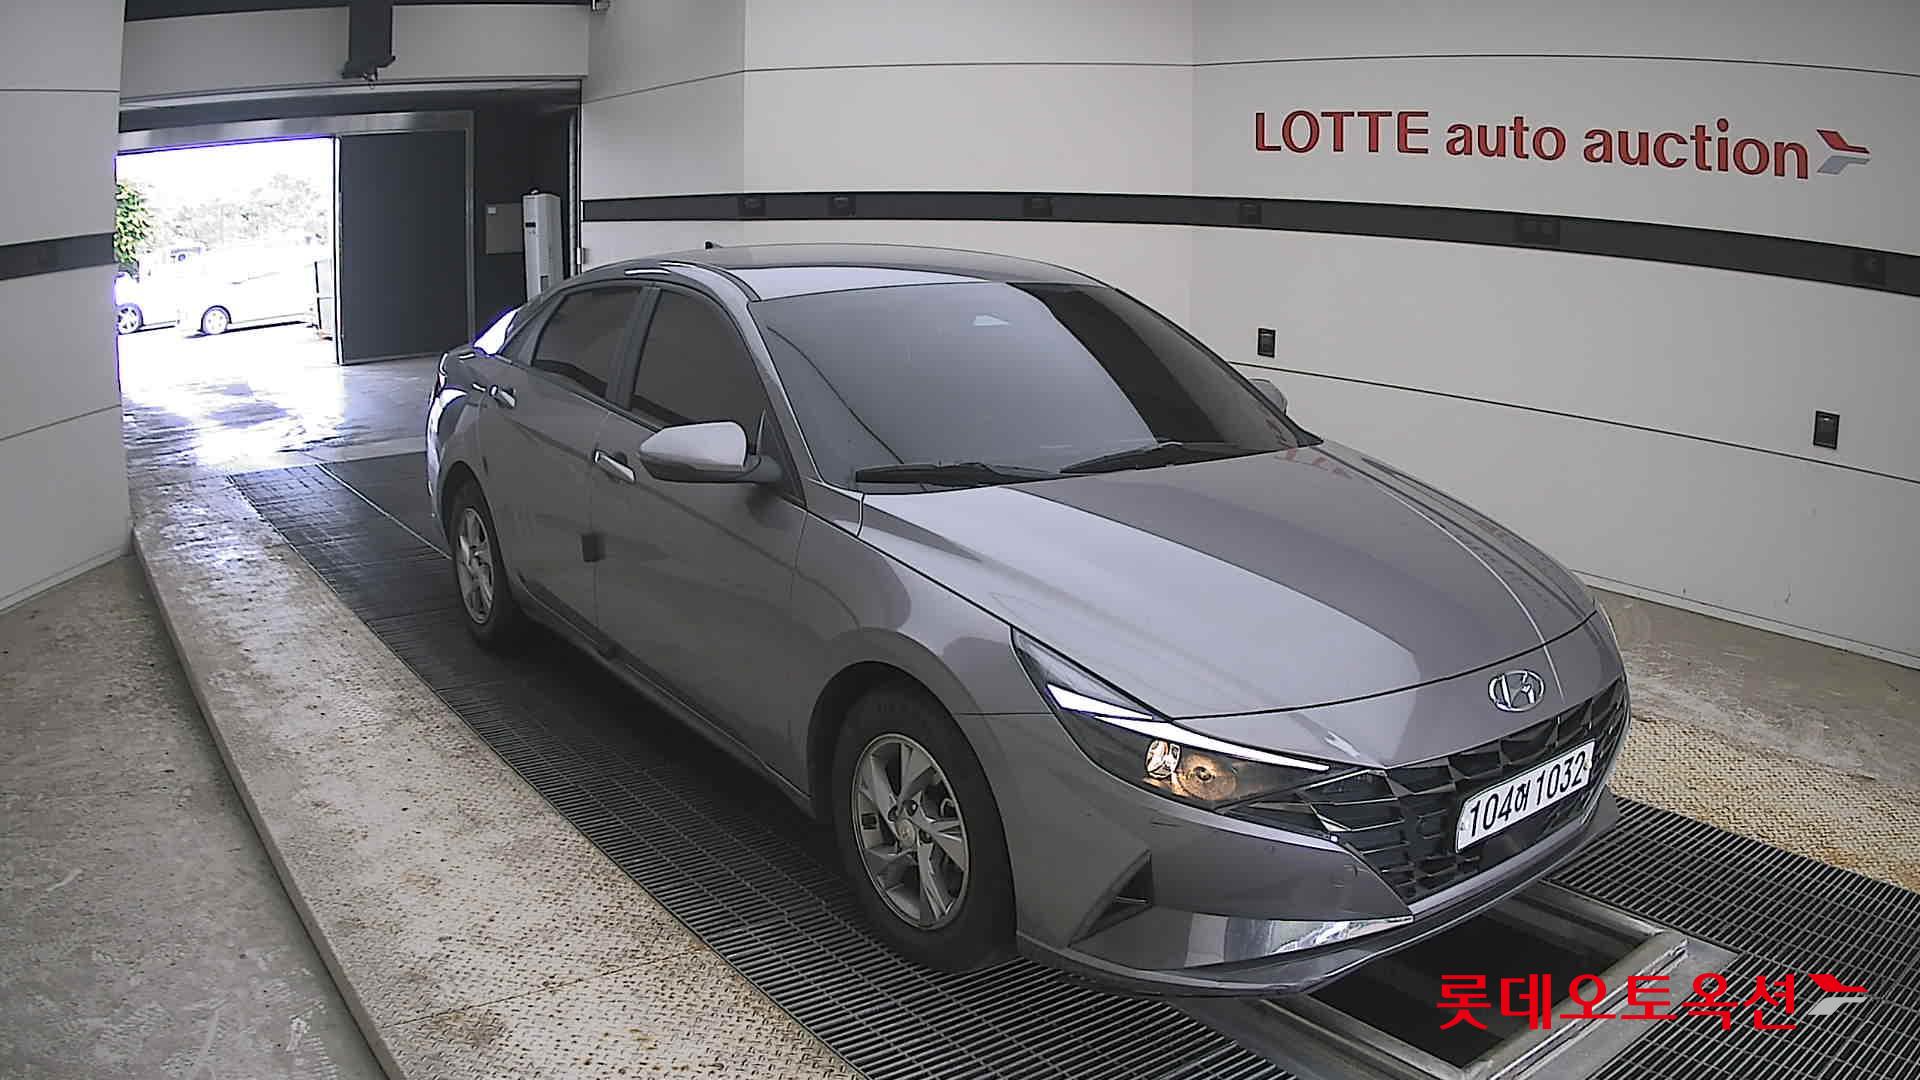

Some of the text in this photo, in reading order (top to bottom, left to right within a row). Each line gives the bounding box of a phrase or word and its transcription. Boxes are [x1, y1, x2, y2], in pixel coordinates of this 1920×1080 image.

[1255, 110, 1809, 180] LOTTE auto auction
[1536, 751, 1586, 806] 1032
